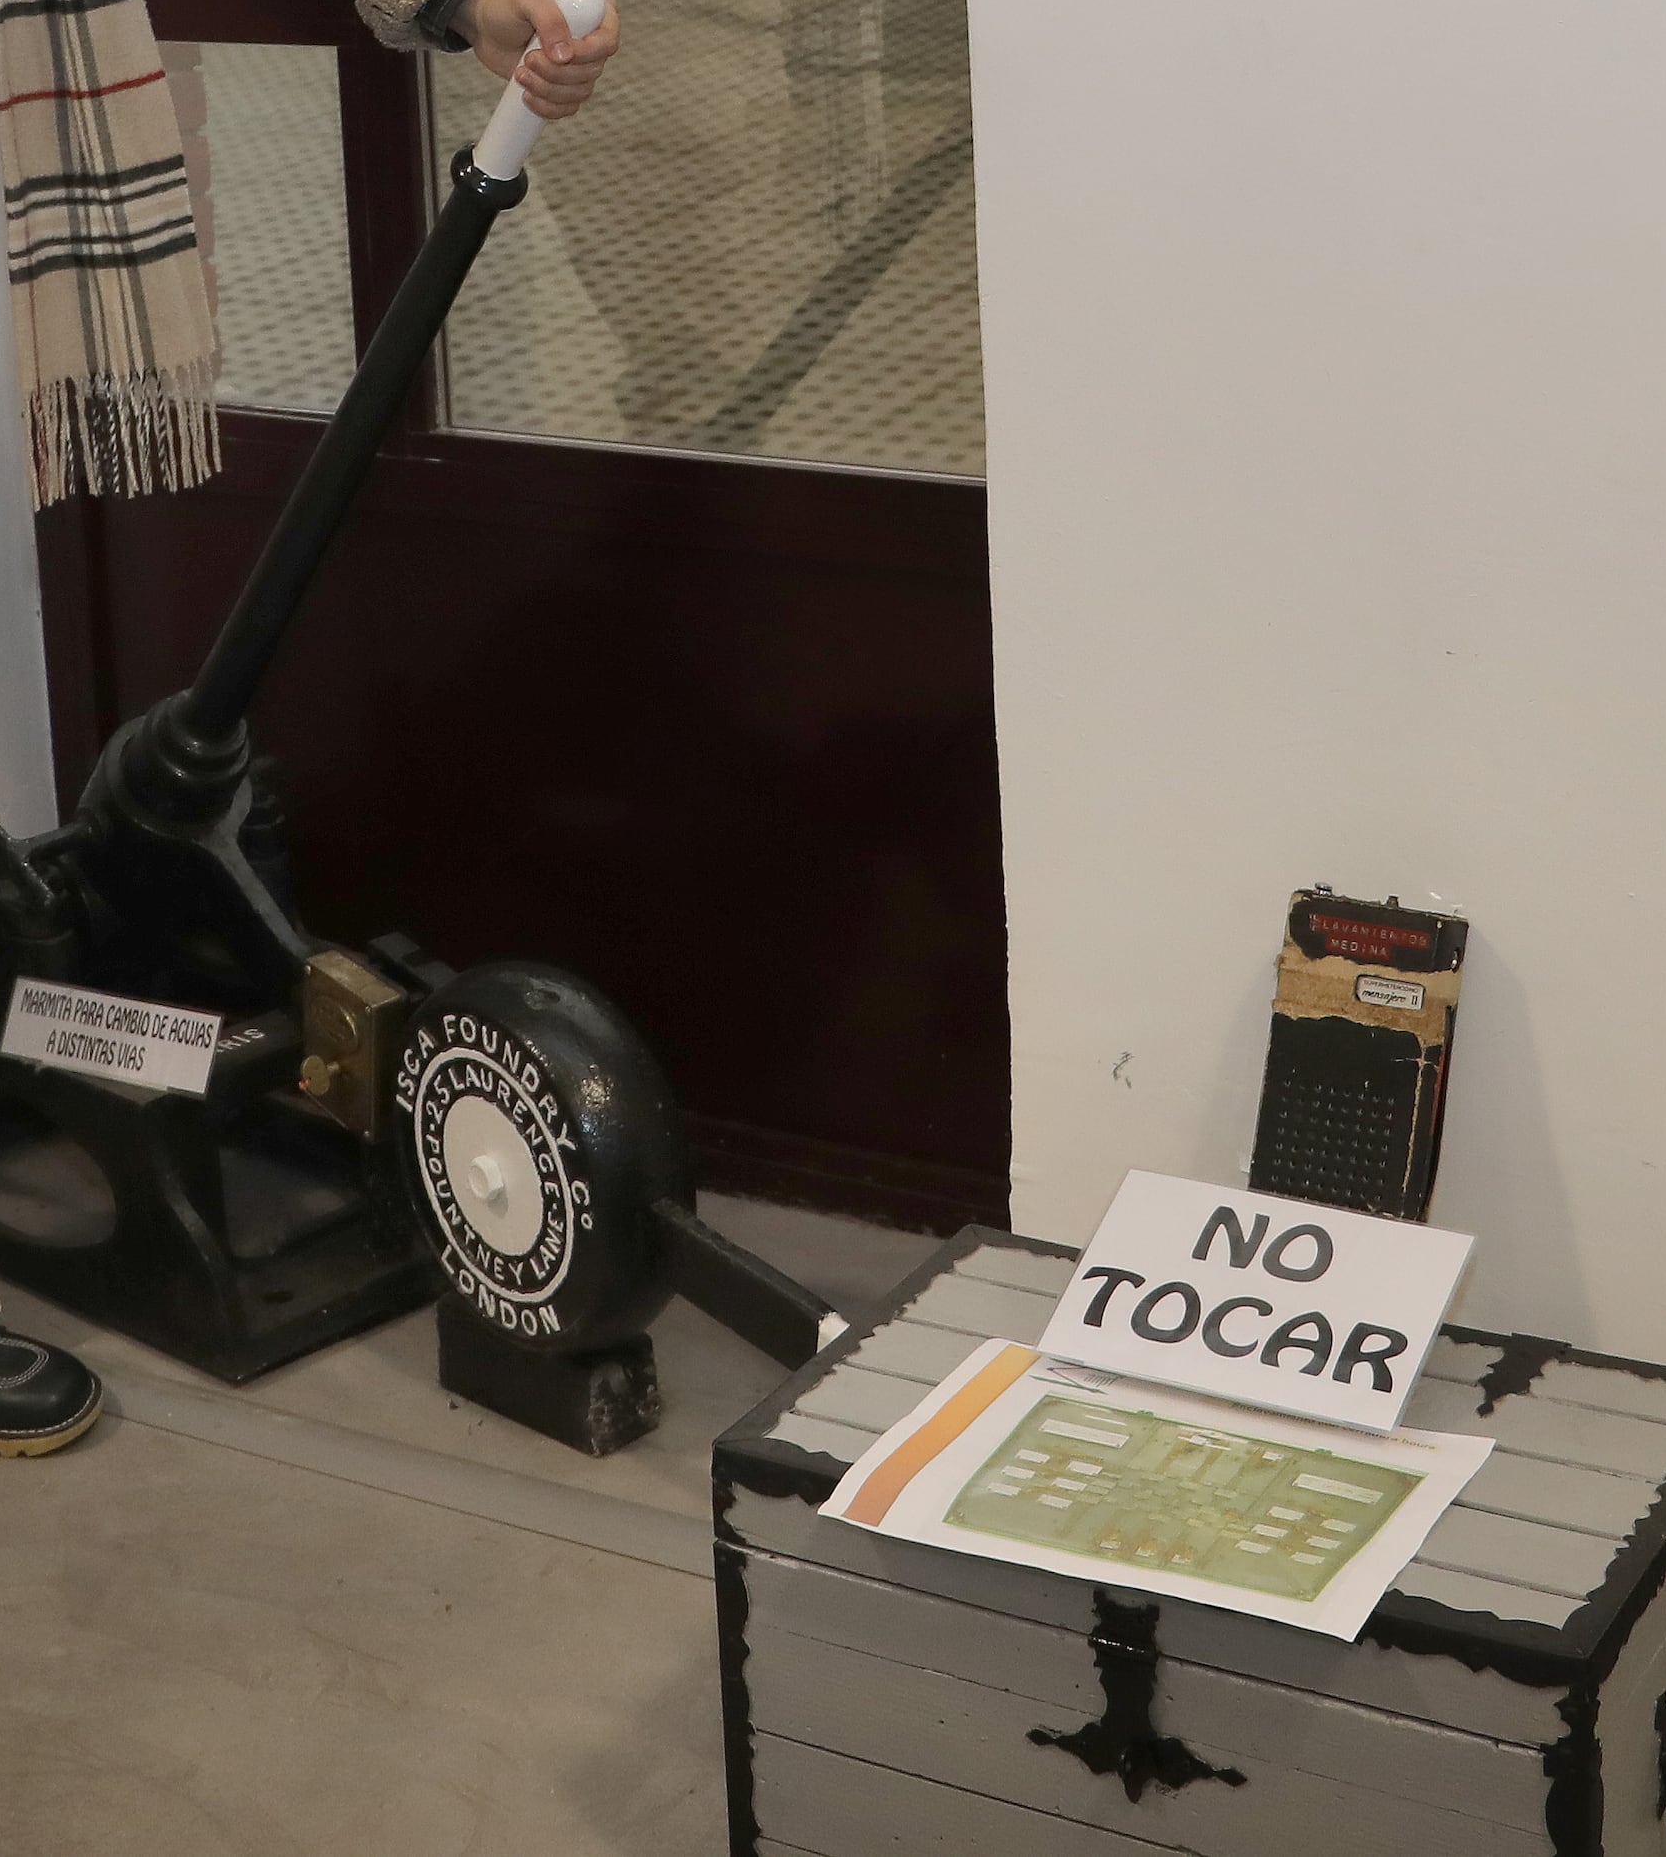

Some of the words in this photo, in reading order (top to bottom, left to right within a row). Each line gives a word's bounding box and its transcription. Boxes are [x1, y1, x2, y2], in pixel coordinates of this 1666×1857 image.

[1332, 939, 1387, 956] MEDINA
[21, 989, 72, 1019] MARMITA
[73, 999, 103, 1026] PARA
[106, 1005, 150, 1036] CAMBIO
[151, 1014, 168, 1040] DE
[1362, 990, 1406, 1004] mensajero
[46, 1030, 55, 1052] A
[57, 1034, 116, 1065] DISTINTAS
[118, 1043, 145, 1070] VIAS
[396, 1029, 435, 1113] ISCA
[443, 1014, 576, 1151] FOUNDRY
[426, 1074, 450, 1125] 25
[449, 1064, 560, 1196] LAURENCE
[426, 1133, 523, 1285] POUNTNEY
[530, 1211, 564, 1279] LANE
[1192, 1206, 1334, 1282] NO
[441, 1245, 560, 1336] LONDON
[1082, 1266, 1408, 1393] TOCAR
